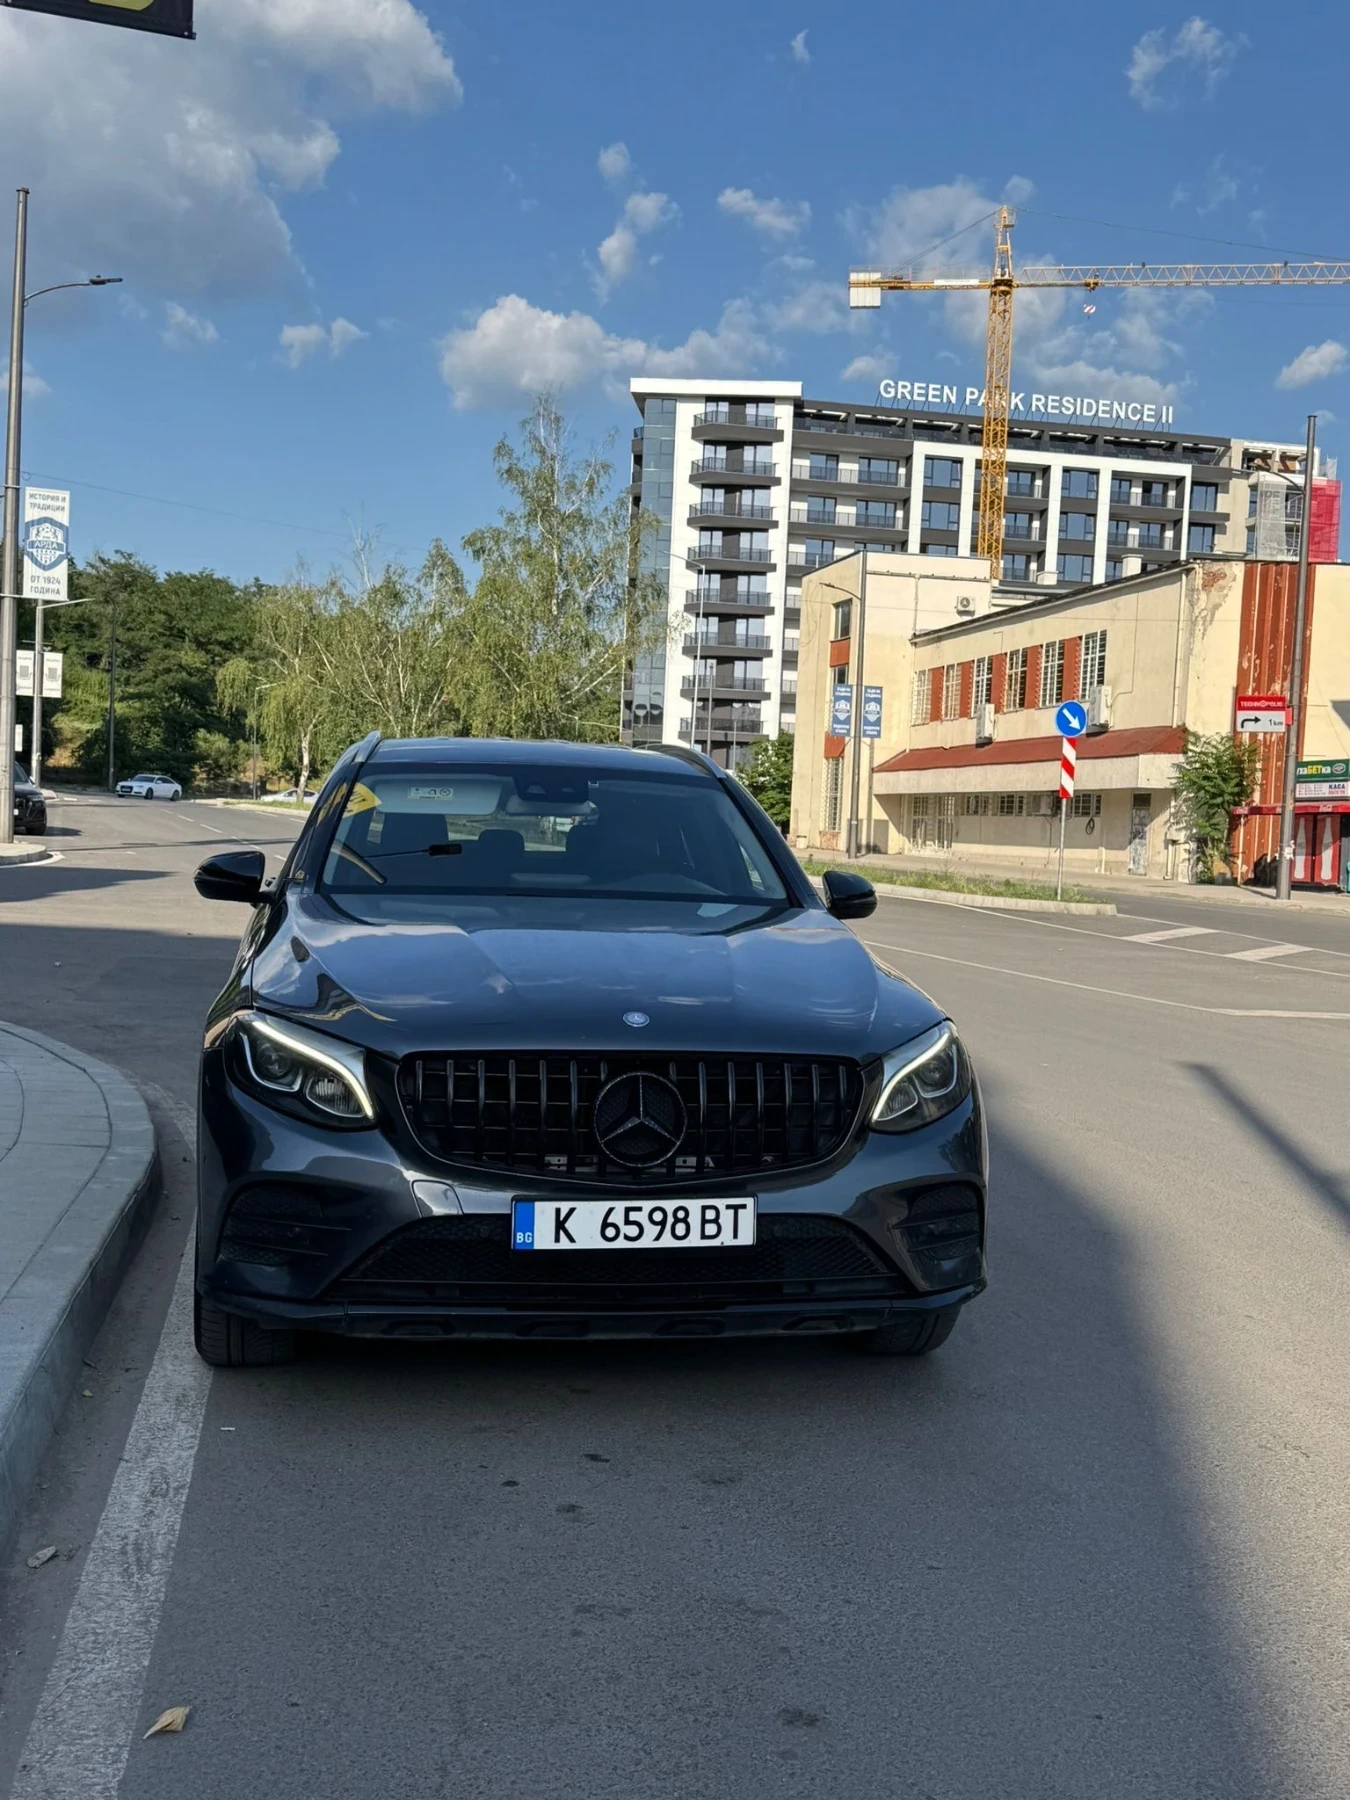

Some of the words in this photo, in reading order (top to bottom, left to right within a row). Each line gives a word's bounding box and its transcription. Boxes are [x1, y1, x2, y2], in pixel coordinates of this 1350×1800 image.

[879, 379, 957, 404] GREEN
[1031, 393, 1157, 423] RESIDENCE
[1162, 405, 1175, 424] II
[29, 492, 60, 502] ИСТОРИЯ
[29, 502, 65, 512] ТРАДИЦИИ
[35, 541, 58, 550] АРДА
[30, 575, 41, 583] ОТ
[43, 576, 61, 585] 1924
[30, 586, 61, 595] ГОДИНА
[516, 1232, 532, 1244] BG
